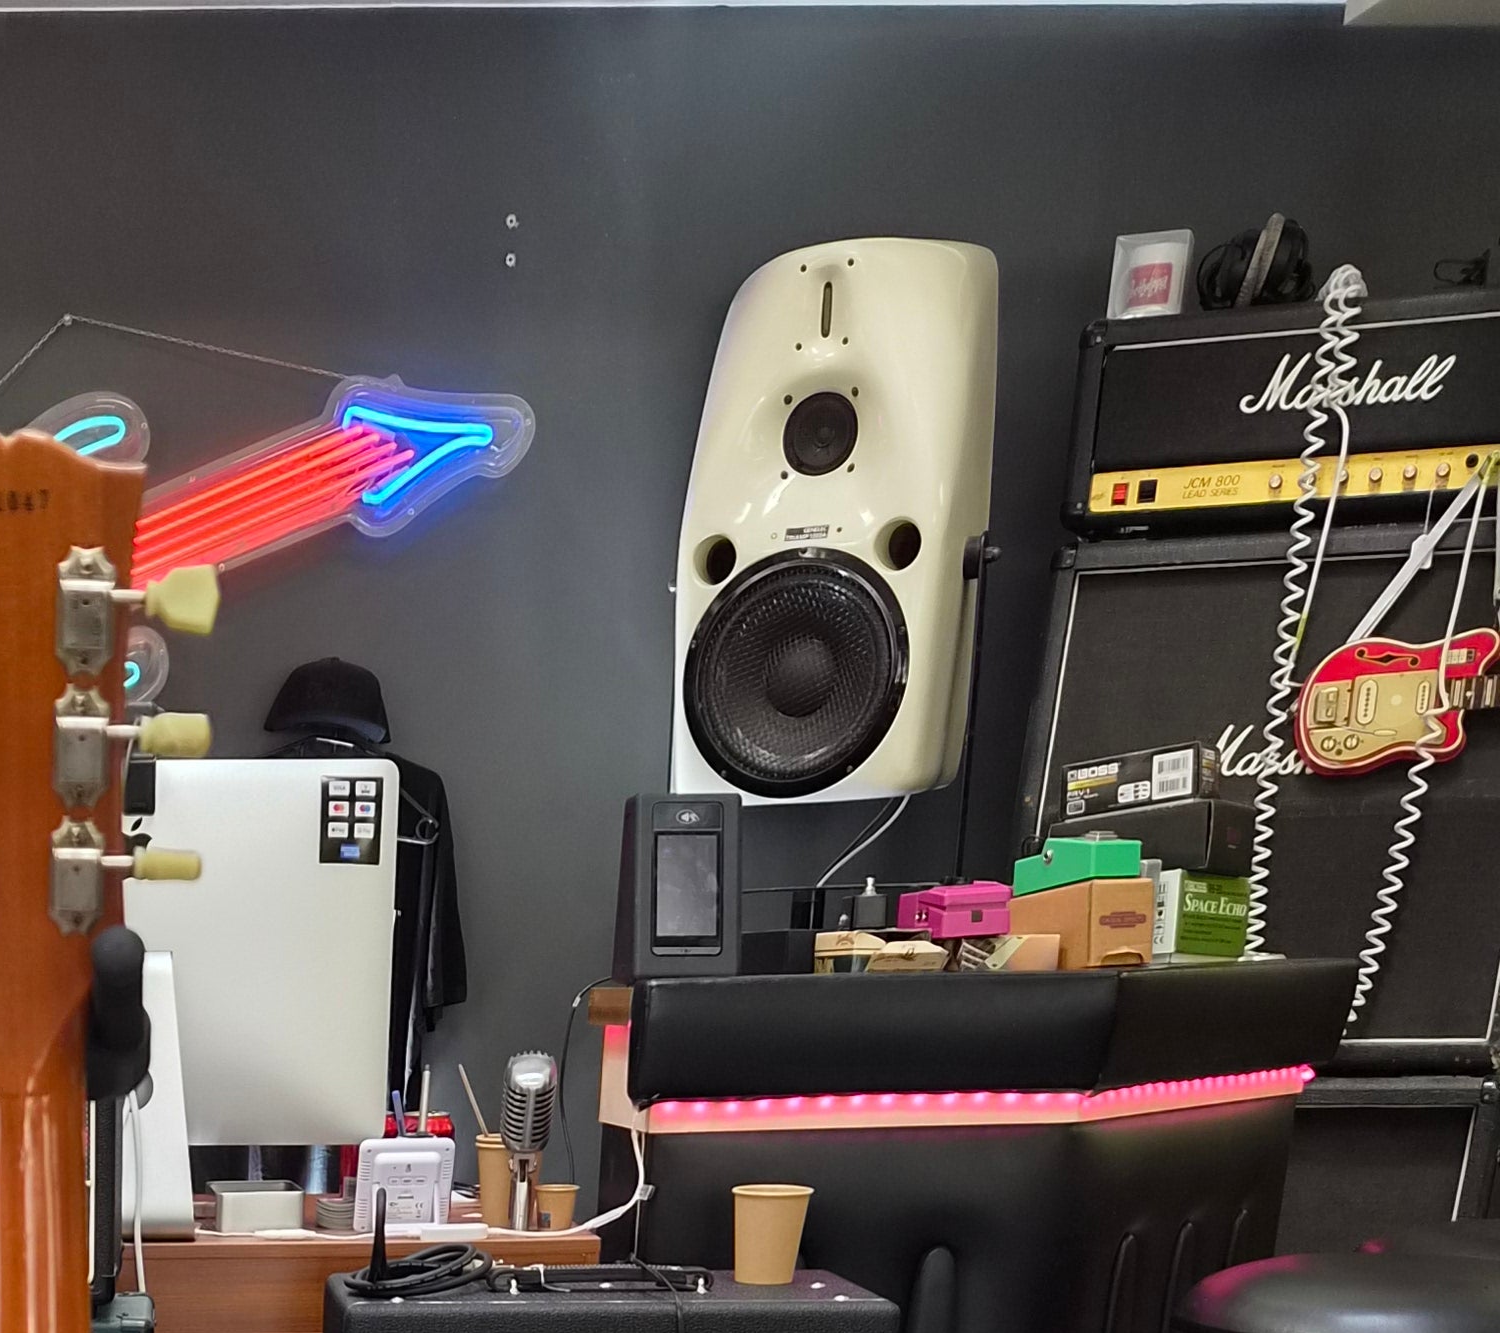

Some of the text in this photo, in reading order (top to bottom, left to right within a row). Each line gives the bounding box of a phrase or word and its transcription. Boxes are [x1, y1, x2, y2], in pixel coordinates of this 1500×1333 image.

[1183, 475, 1241, 490] JCM 800
[1182, 487, 1239, 499] LEAD SERIES
[1183, 893, 1247, 917] SPACE ECHO
